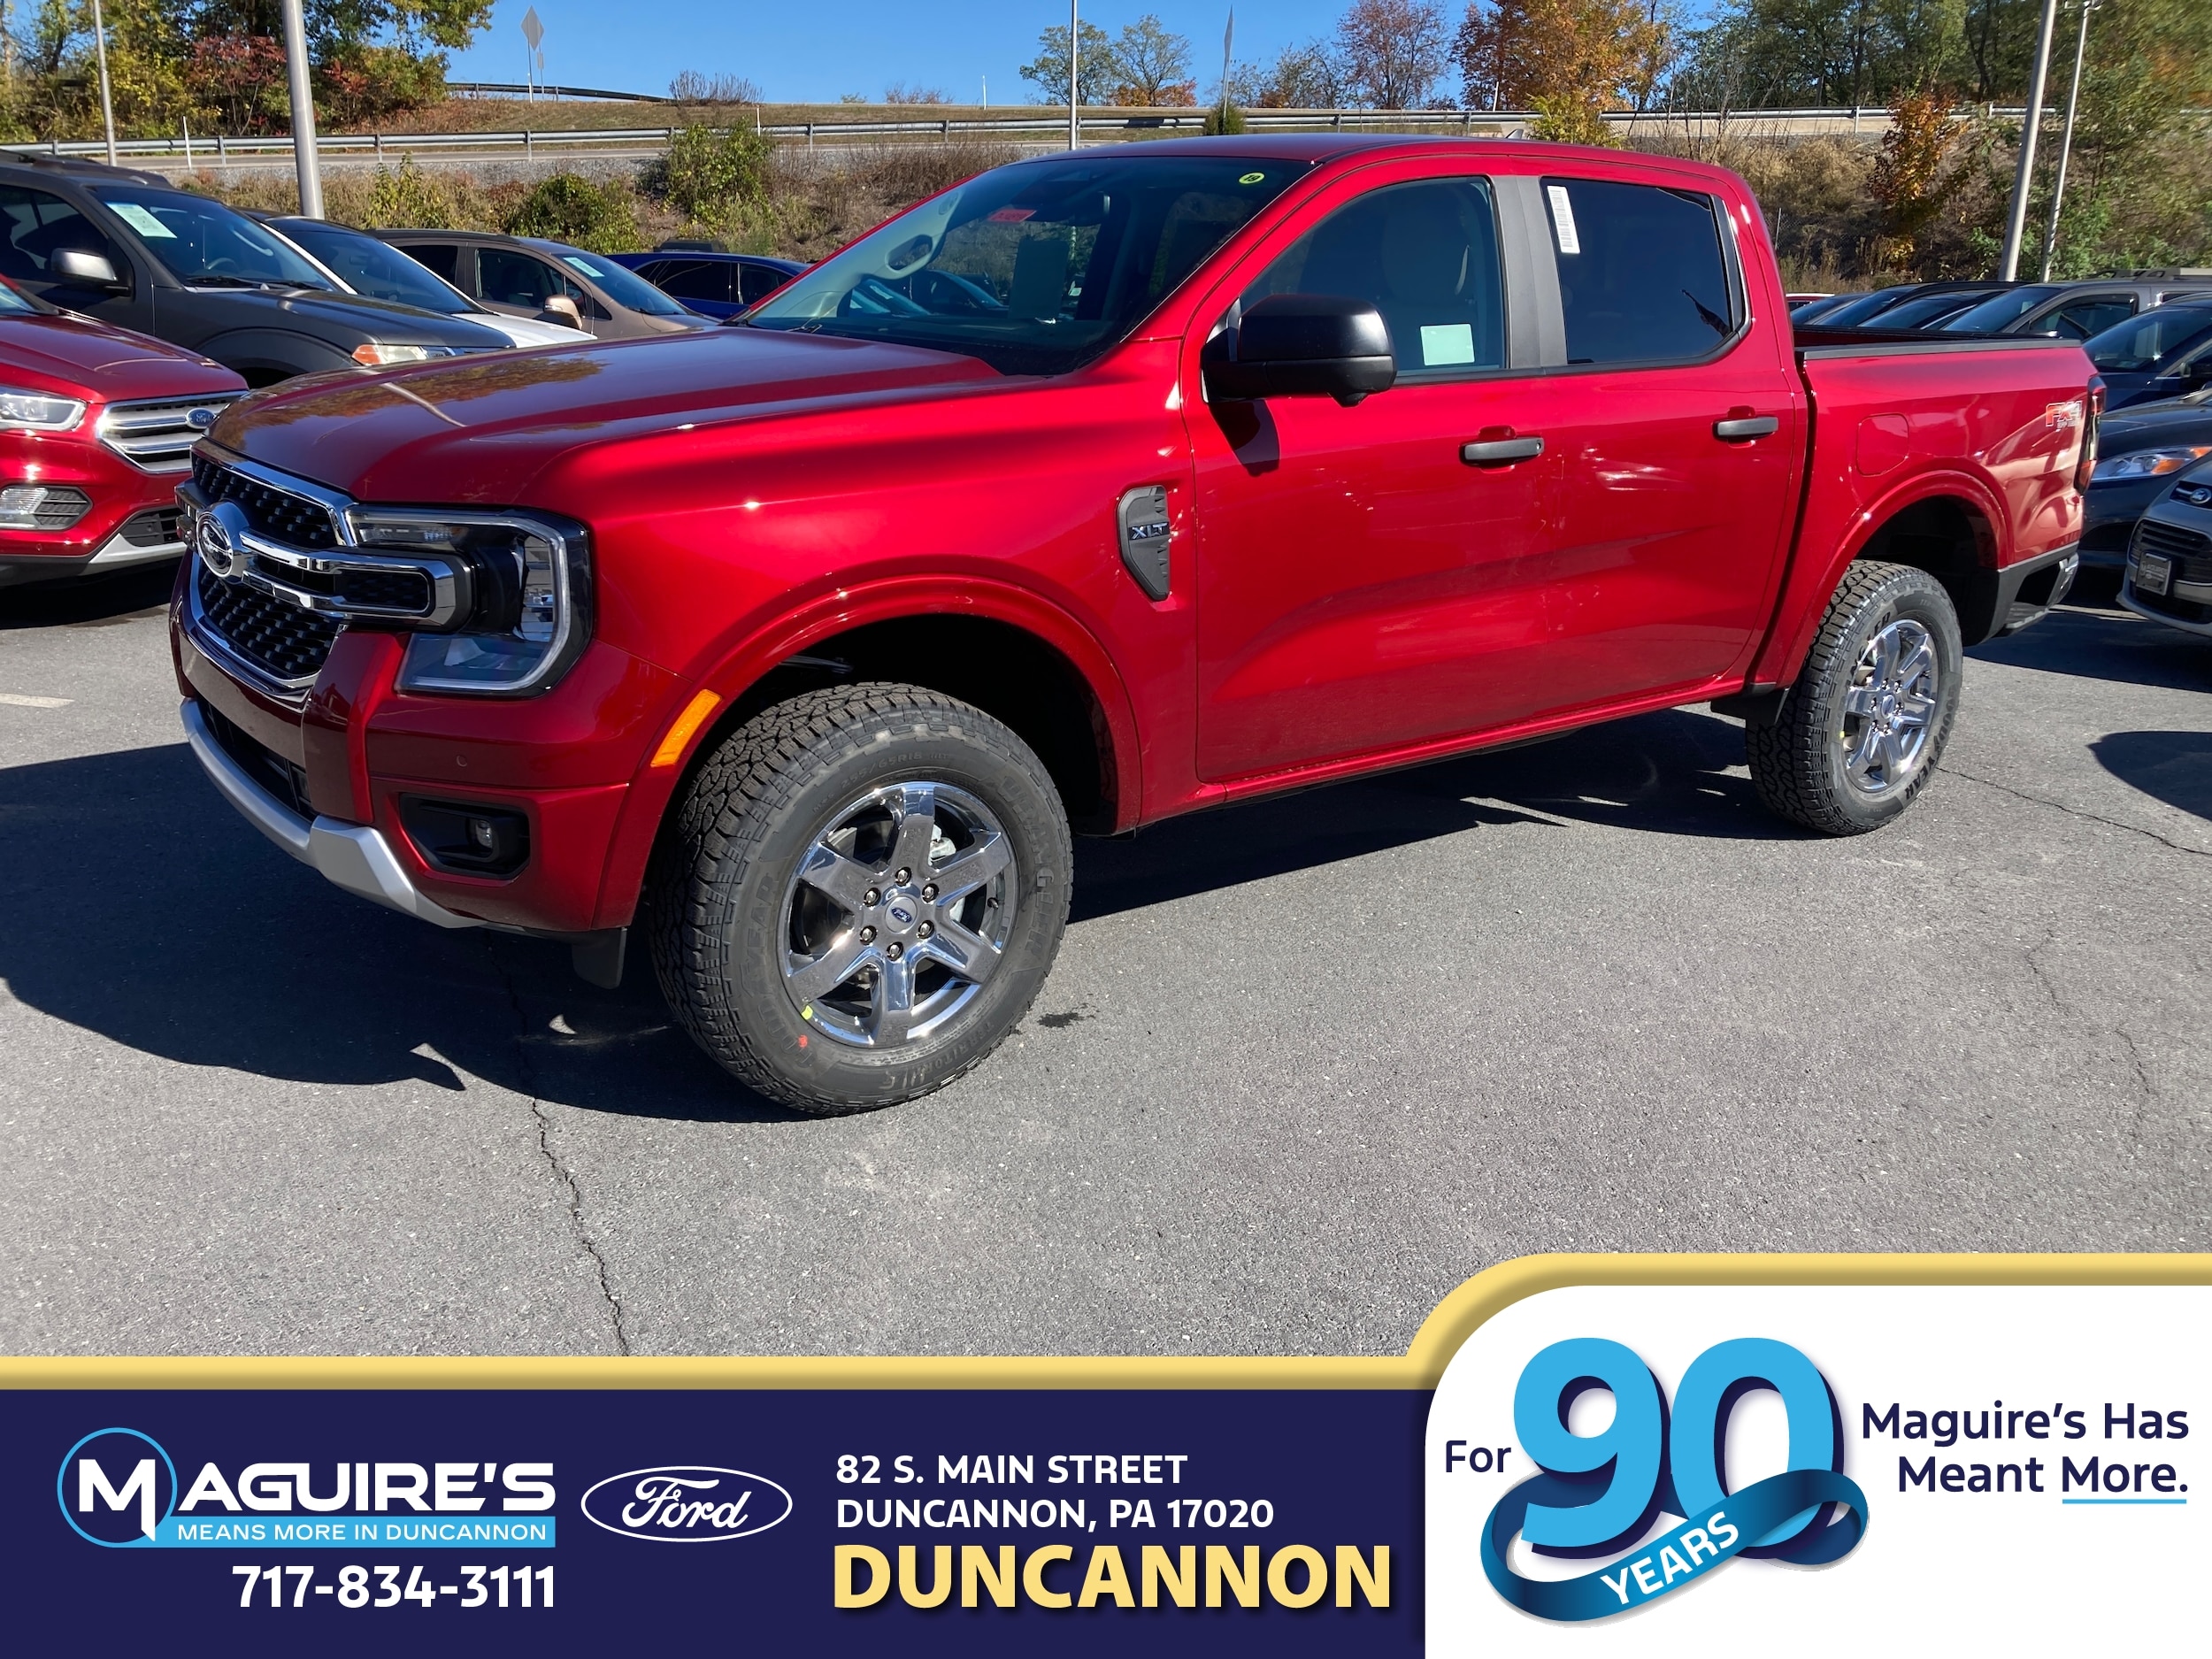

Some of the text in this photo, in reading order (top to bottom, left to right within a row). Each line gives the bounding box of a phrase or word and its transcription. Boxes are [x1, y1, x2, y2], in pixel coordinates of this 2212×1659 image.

[2046, 401, 2082, 426] FX4
[1133, 523, 1168, 539] XLT
[841, 751, 923, 789] 255/65R18
[998, 775, 1056, 957] WRANGLER
